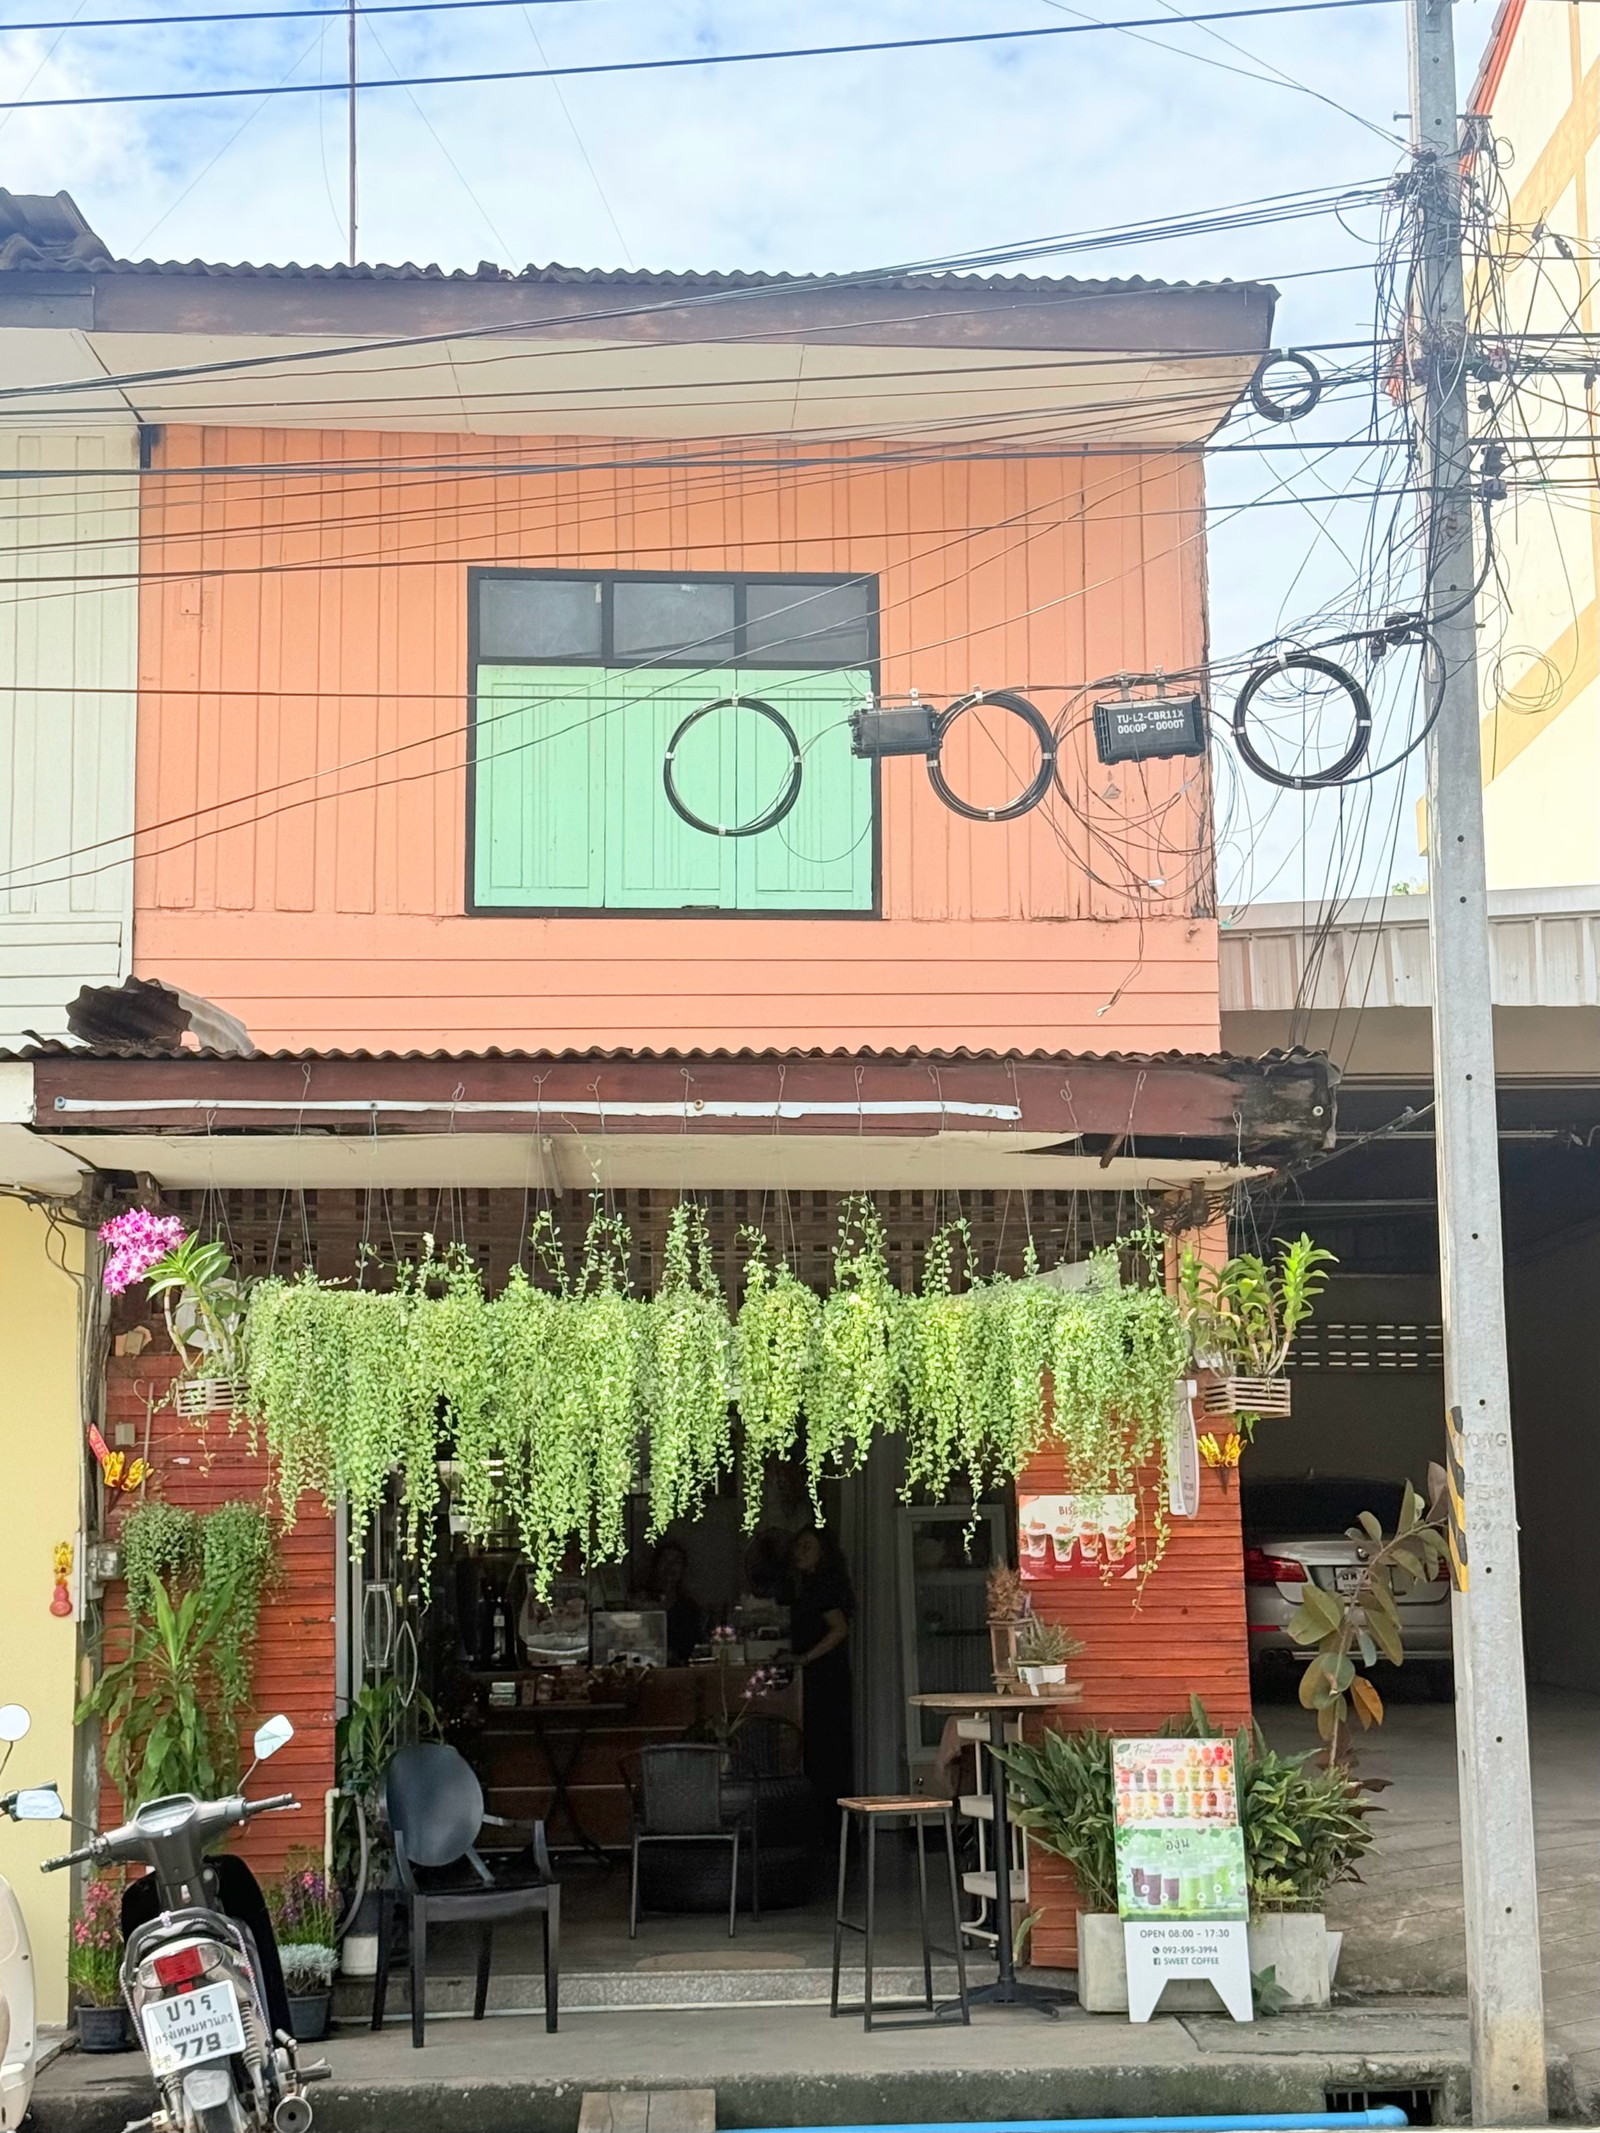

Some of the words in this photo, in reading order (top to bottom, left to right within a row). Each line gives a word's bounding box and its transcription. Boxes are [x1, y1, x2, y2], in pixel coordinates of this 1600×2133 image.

[1166, 1835, 1190, 1854] องุ่น
[1140, 1929, 1165, 1938] OPEN
[1205, 1929, 1230, 1938] 17:30
[1162, 1946, 1218, 1954] 092-595-3994
[1164, 1957, 1189, 1965] SWEET
[1191, 1957, 1219, 1965] COFFEE
[174, 2032, 221, 2060] 779
